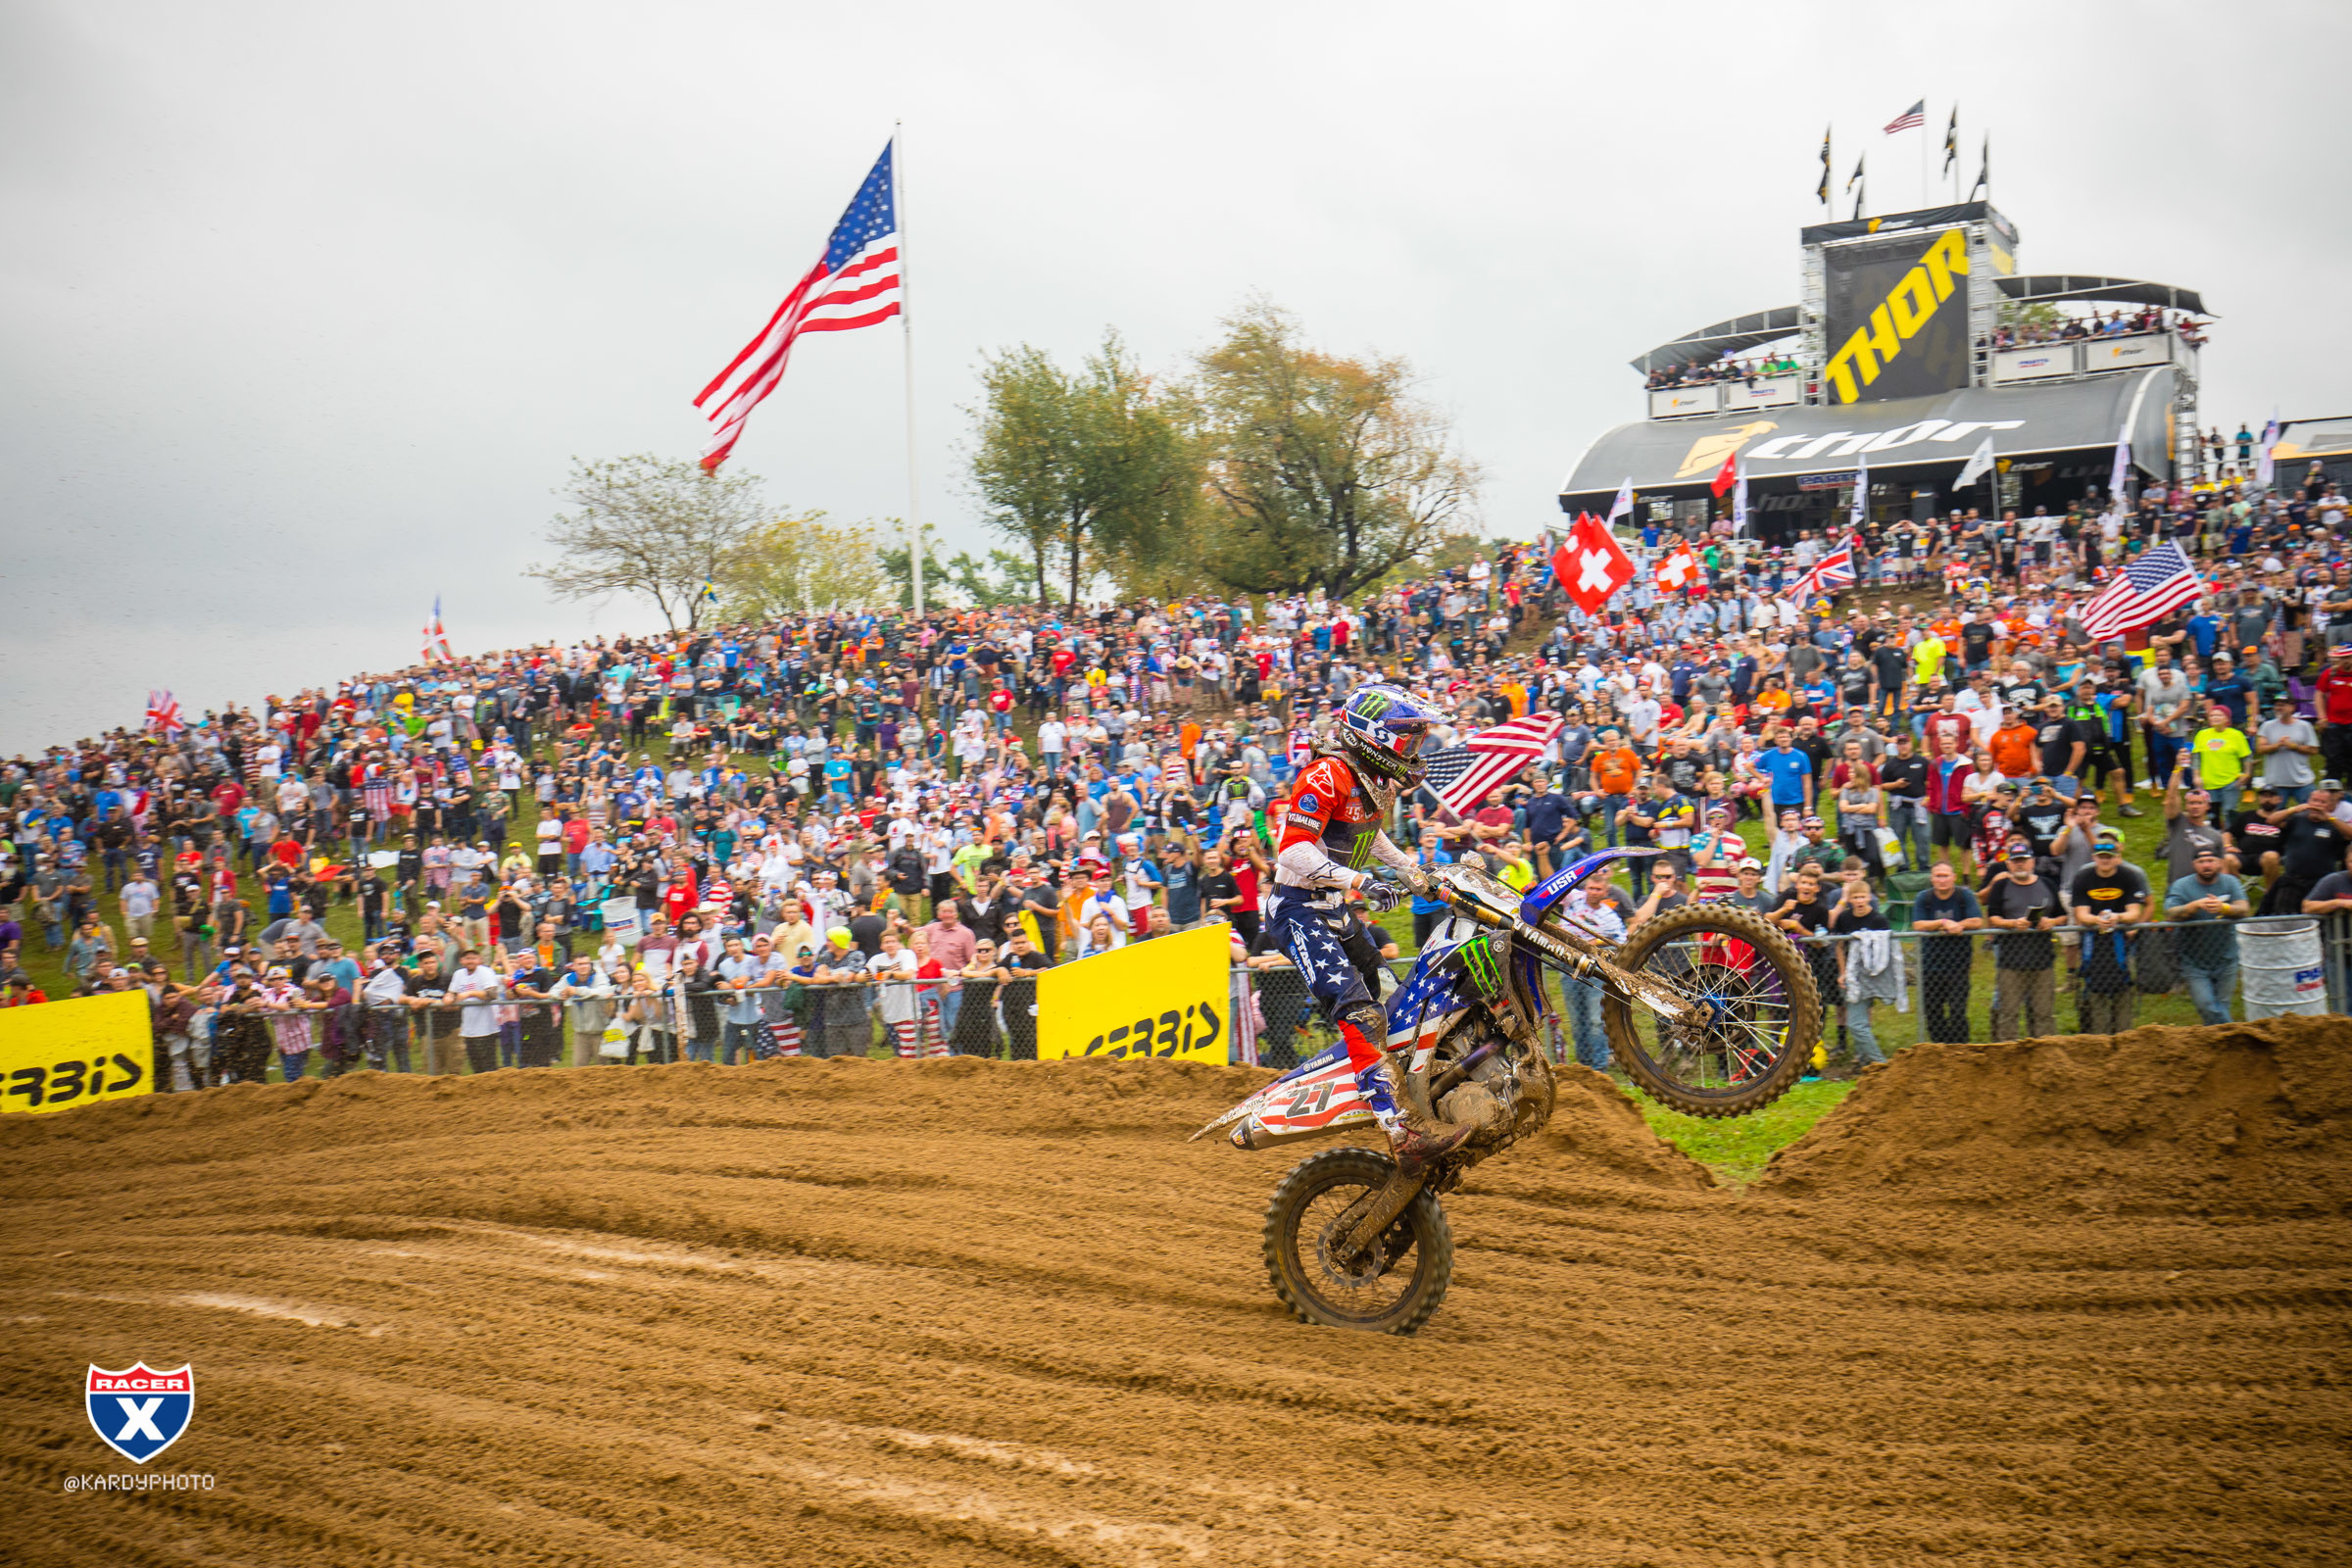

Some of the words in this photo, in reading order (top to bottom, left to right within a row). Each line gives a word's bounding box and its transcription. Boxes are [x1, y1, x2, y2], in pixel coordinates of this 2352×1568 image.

[1825, 228, 1970, 404] THOR
[1743, 418, 2027, 459] thor
[1360, 742, 1397, 770] MONSTER
[1288, 812, 1321, 831] YAMALUBE
[1546, 870, 1578, 895] USA
[1294, 955, 1311, 986] YAMAHA
[1310, 1054, 1335, 1070] YAMAHA
[1286, 1082, 1335, 1118] 27
